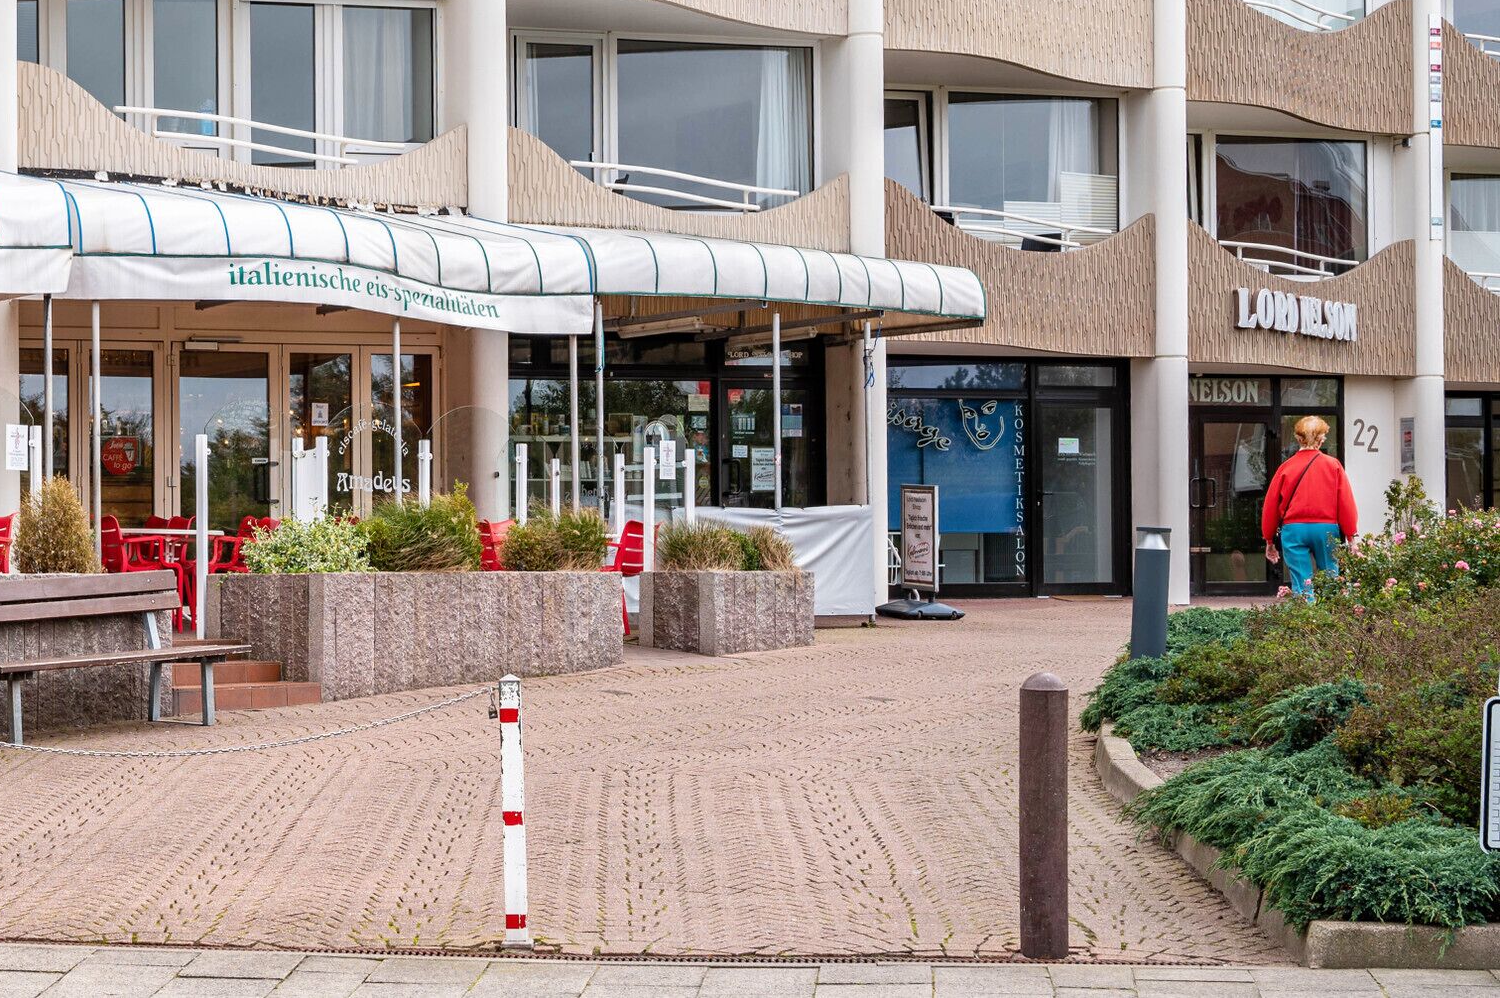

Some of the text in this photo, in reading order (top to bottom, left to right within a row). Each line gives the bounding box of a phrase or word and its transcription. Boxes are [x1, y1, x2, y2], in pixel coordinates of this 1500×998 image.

[227, 261, 501, 319] italienische eis-spezialitäten
[1234, 287, 1358, 342] LORD NELSON
[338, 418, 409, 457] eiscafé-gelateia
[887, 402, 952, 451] isage
[1352, 418, 1379, 453] 22
[1013, 404, 1026, 577] KOSMETIKSALON
